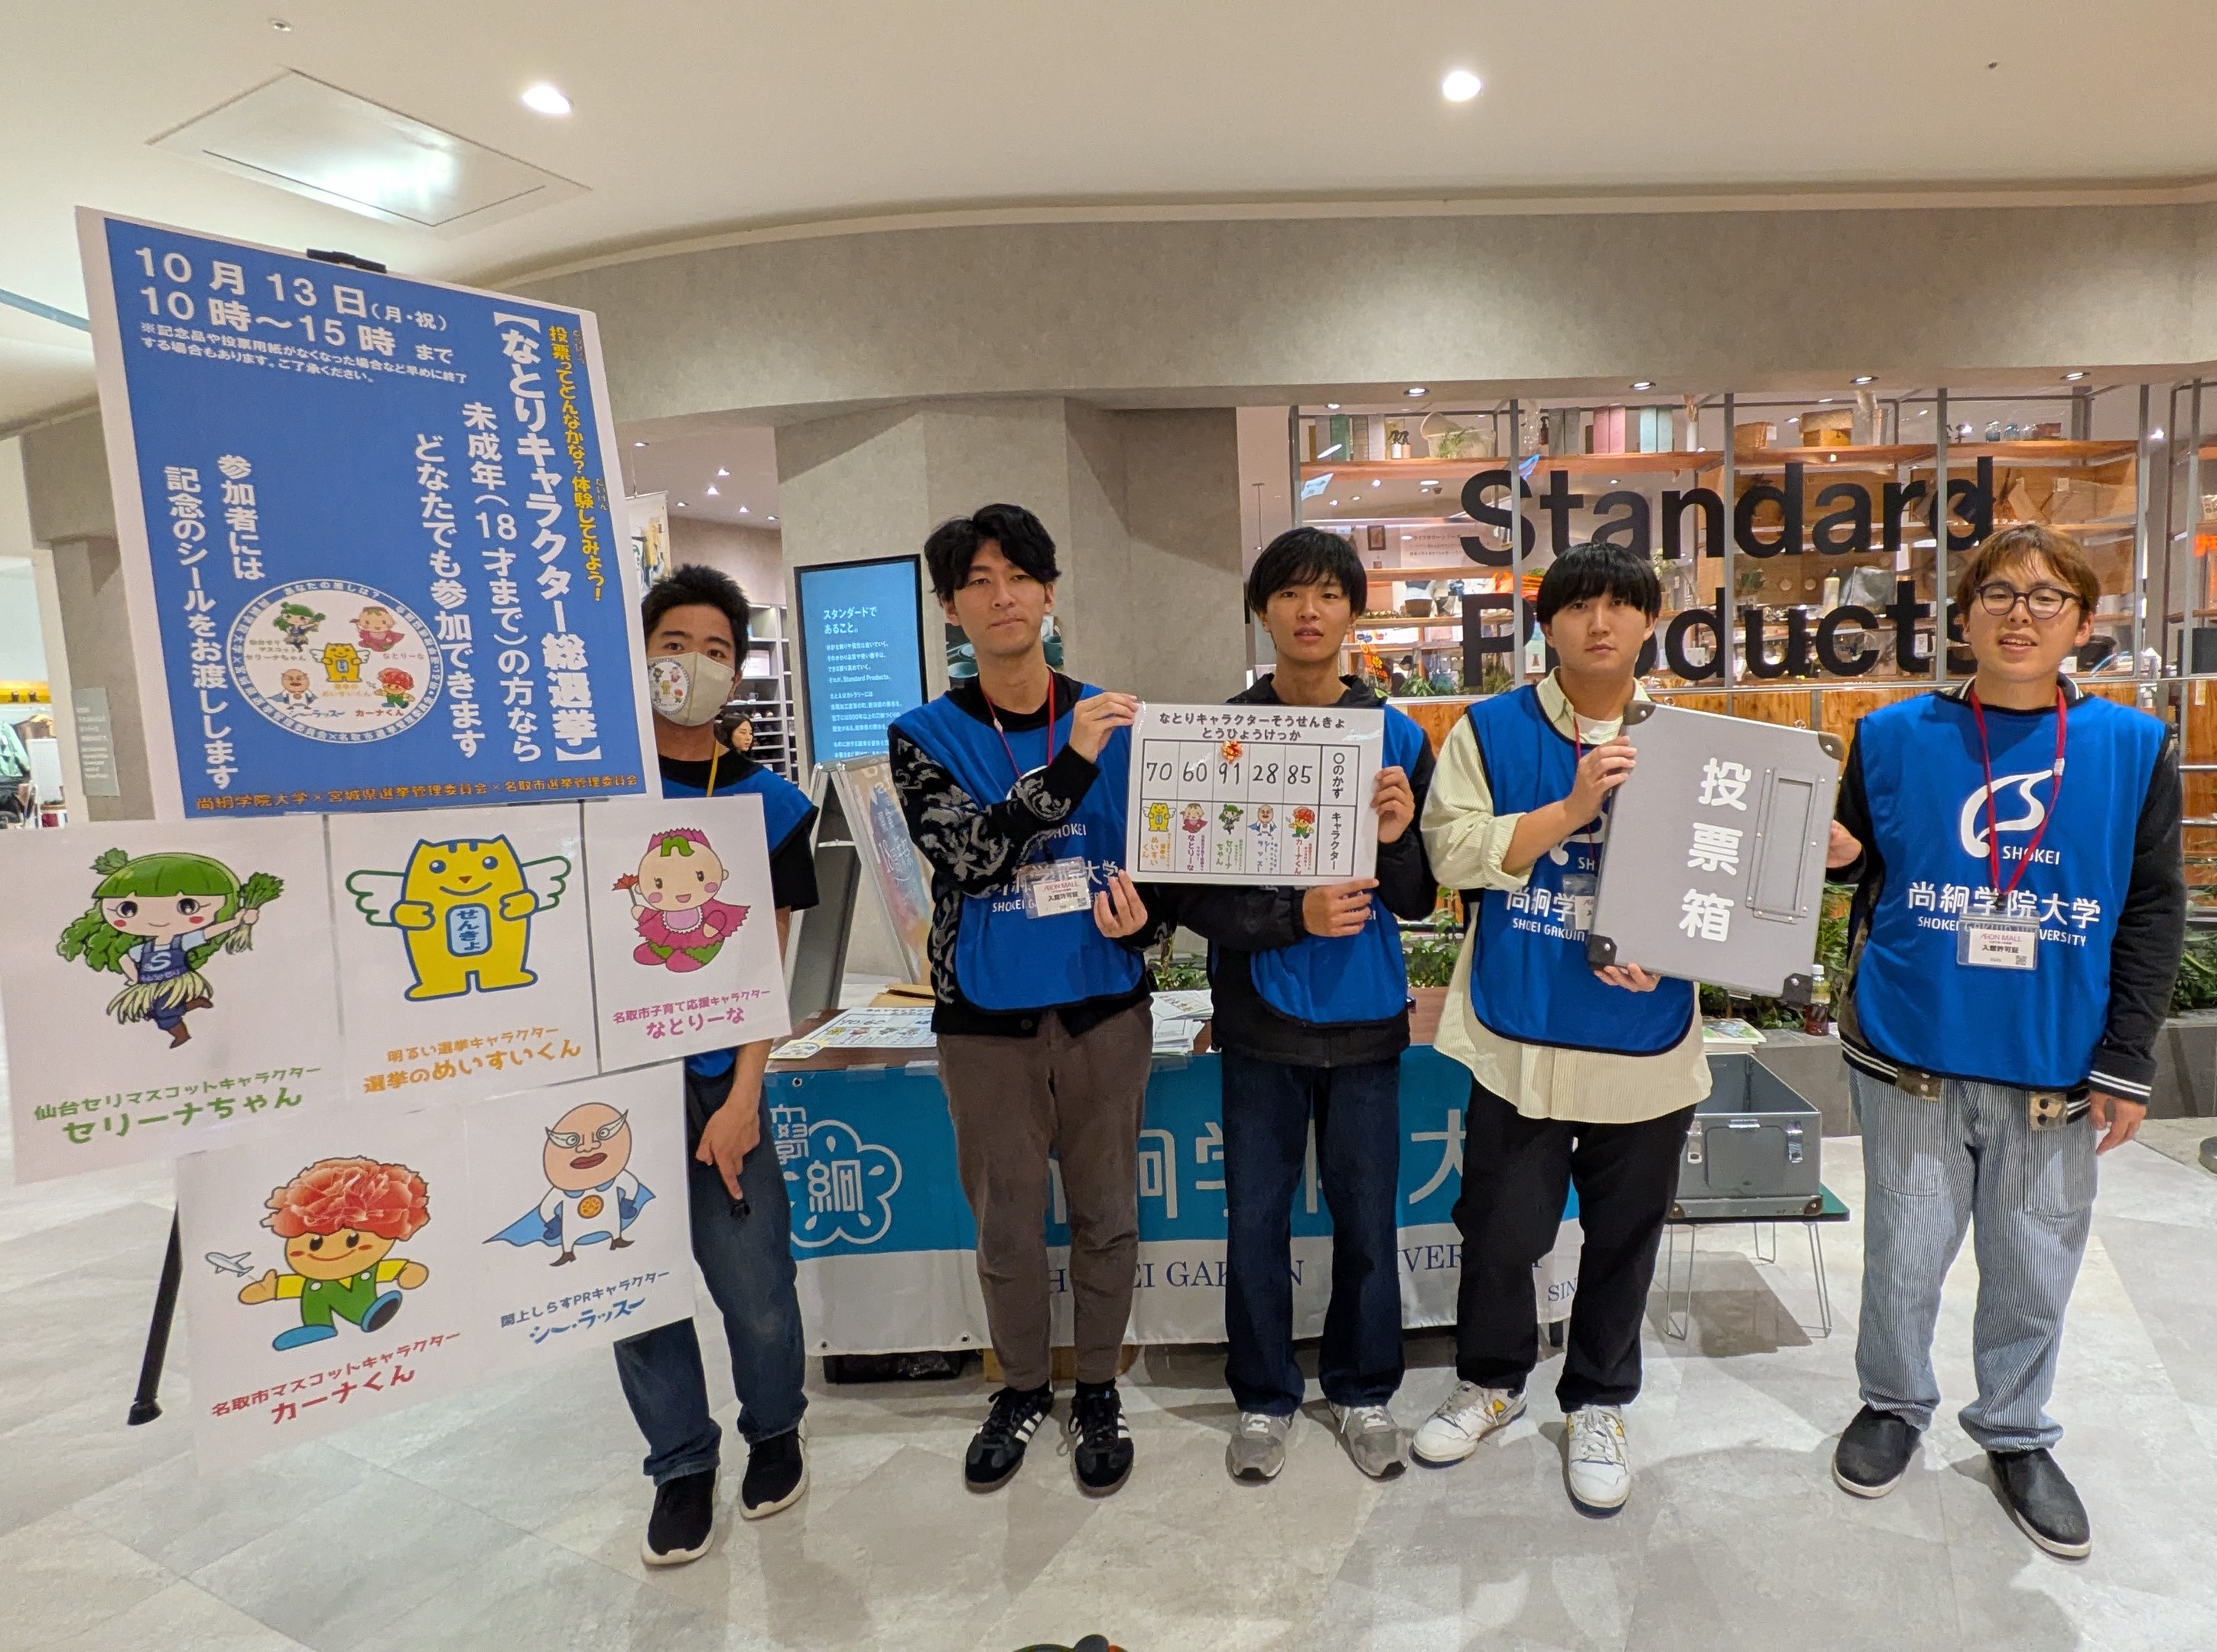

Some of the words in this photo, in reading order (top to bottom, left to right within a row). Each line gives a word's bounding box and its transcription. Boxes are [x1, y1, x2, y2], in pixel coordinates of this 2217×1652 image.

[216, 454, 265, 581] 参加者には
[1461, 457, 1993, 567] Standard
[414, 433, 486, 759] どなたでも参加できます
[824, 606, 877, 620] スタンダードで
[164, 465, 239, 789] 記念のシールをお渡しします
[824, 622, 859, 634] あること。
[1462, 580, 1978, 686] Pduct
[1159, 712, 1346, 729] なとりキャラクターそうせんきょ
[1201, 727, 1301, 741] とうひょうけっか
[1146, 762, 1173, 782] 70
[1182, 760, 1208, 782] 60
[1218, 762, 1240, 785] 91
[1253, 762, 1280, 785] 28
[1287, 763, 1314, 785] 85
[1054, 823, 1087, 839] HOKEI
[1329, 811, 1342, 870] キャラクター
[1678, 756, 1753, 942] 投票箱
[1187, 834, 1196, 871] なとりーな
[1907, 880, 2102, 930] 尚絅学院大学
[456, 909, 482, 951] せんきょ
[1543, 923, 1585, 942] GAKUIN
[2001, 934, 2022, 942] MALL
[613, 989, 771, 1024] 名取市子育て応援キャラクター
[646, 1006, 746, 1040] なとりーな
[387, 1026, 560, 1063] 明るい選挙キャラクター
[362, 1039, 582, 1094] 選挙のめいすいくん
[34, 1066, 321, 1121] 仙台セリマスコットキャラクター
[62, 1086, 303, 1145] セリーナちゃん
[1166, 1260, 1305, 1288] GAN
[1547, 1276, 1578, 1302] SIN
[211, 1332, 461, 1417] 名取市マスコットキャラクター
[271, 1365, 415, 1425] カーナくん
